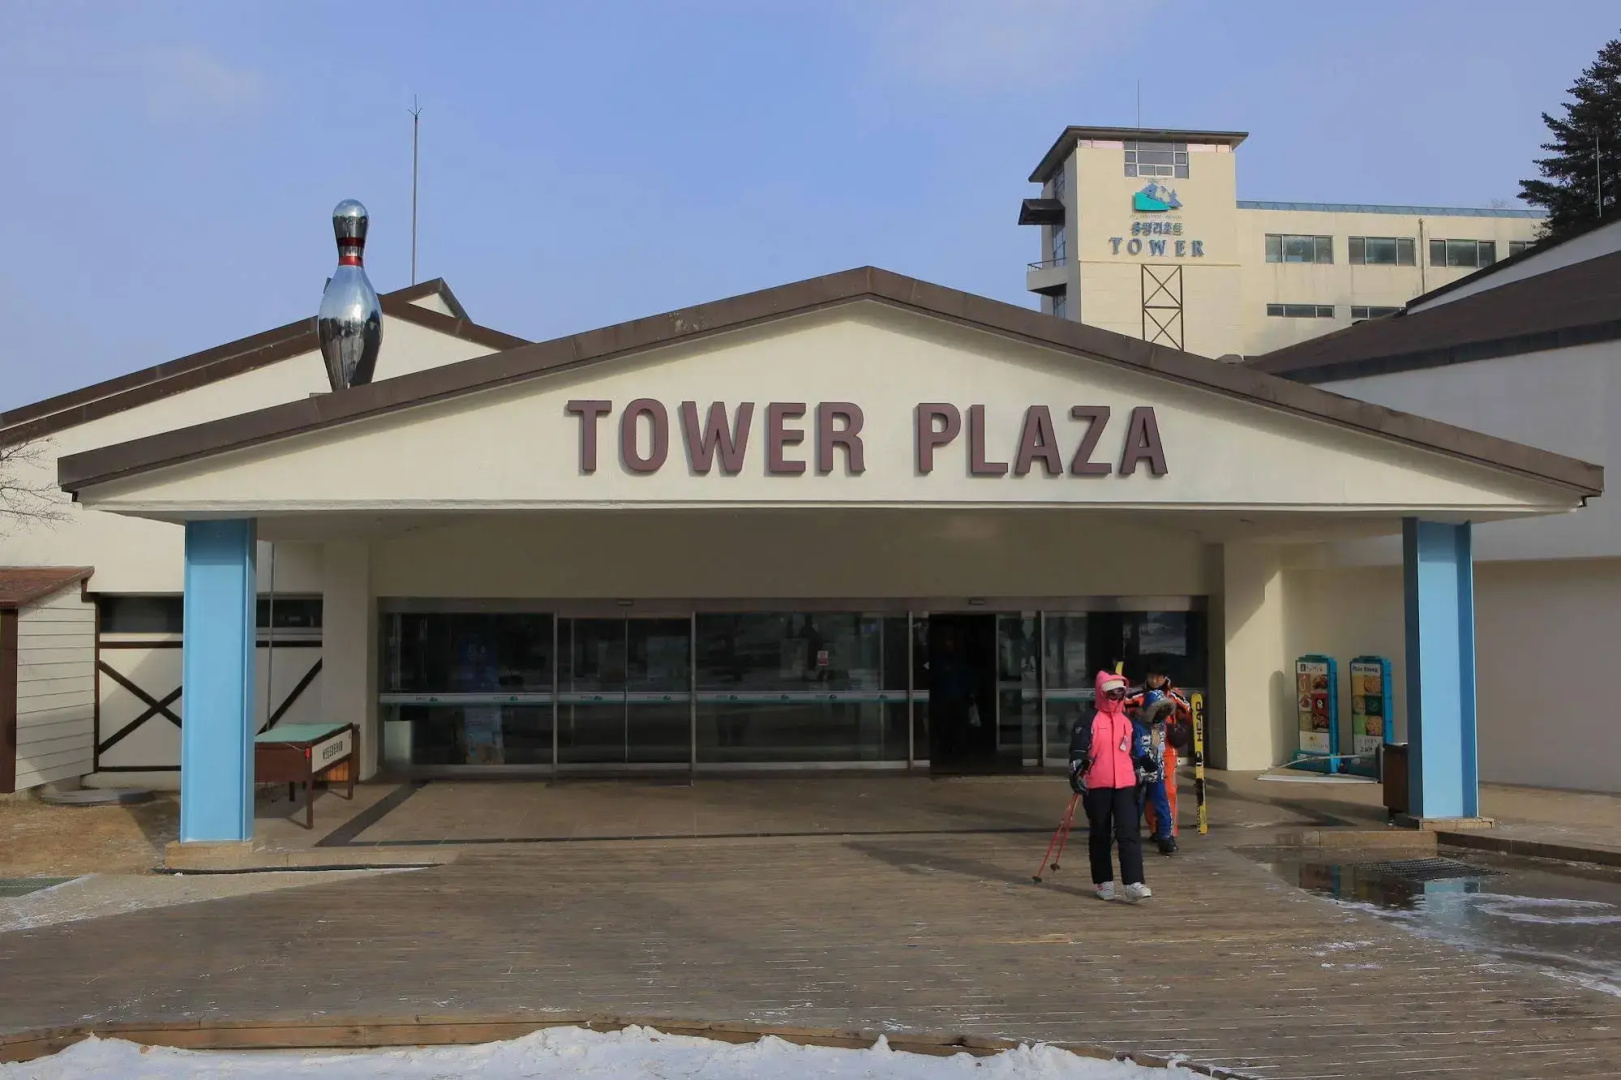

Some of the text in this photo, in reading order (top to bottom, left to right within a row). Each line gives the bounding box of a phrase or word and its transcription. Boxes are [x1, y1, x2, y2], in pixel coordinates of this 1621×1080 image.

[1109, 237, 1205, 257] TOWER
[566, 398, 1168, 477] TOWER PLAZA
